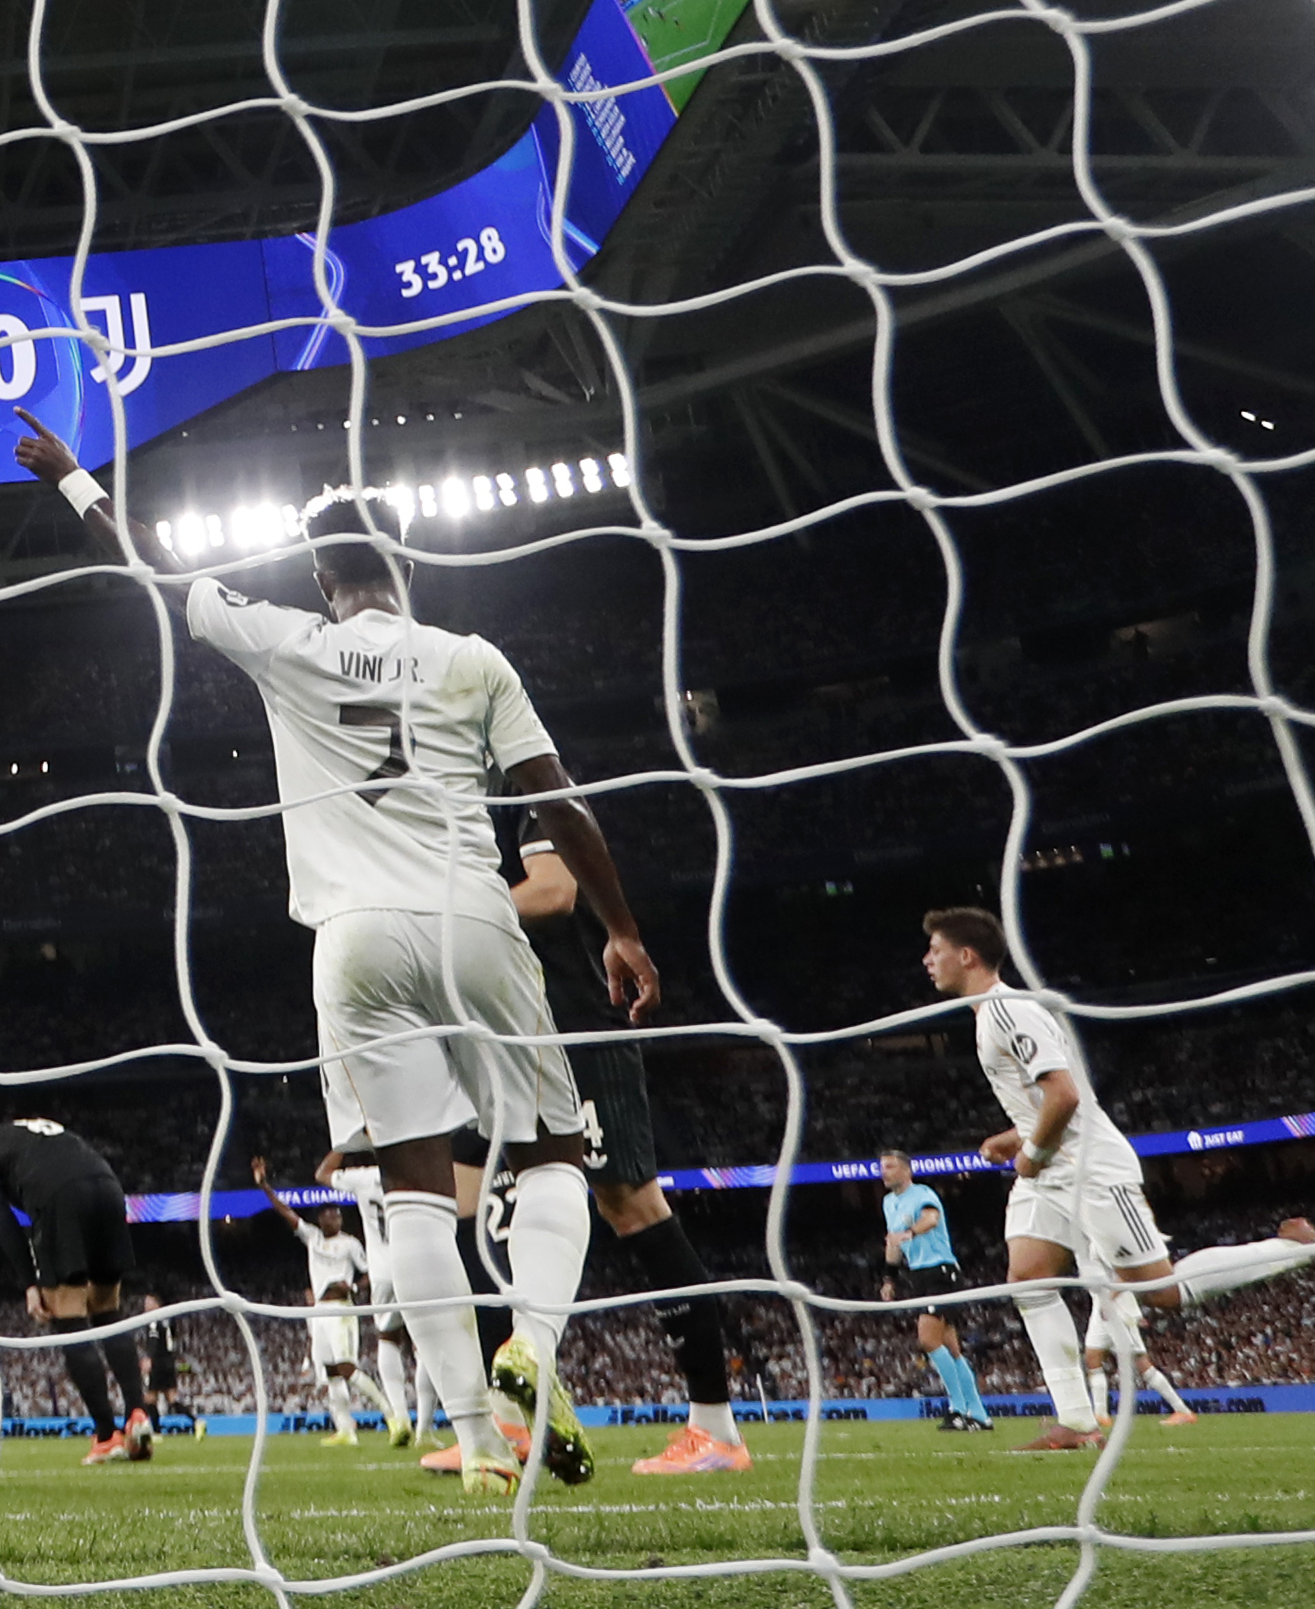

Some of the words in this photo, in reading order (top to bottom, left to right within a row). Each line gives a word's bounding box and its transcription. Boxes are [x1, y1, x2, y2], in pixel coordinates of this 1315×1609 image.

[394, 226, 507, 299] 33:28
[339, 650, 383, 685] VINI
[339, 704, 416, 806] 7
[1204, 1132, 1226, 1147] JUST
[1227, 1130, 1244, 1144] EAT
[832, 1162, 869, 1179] UEFA
[869, 1156, 955, 1178] CPIONS
[955, 1153, 996, 1170] LEAG
[275, 1190, 302, 1206] EFA
[303, 1189, 358, 1205] CHAMPI
